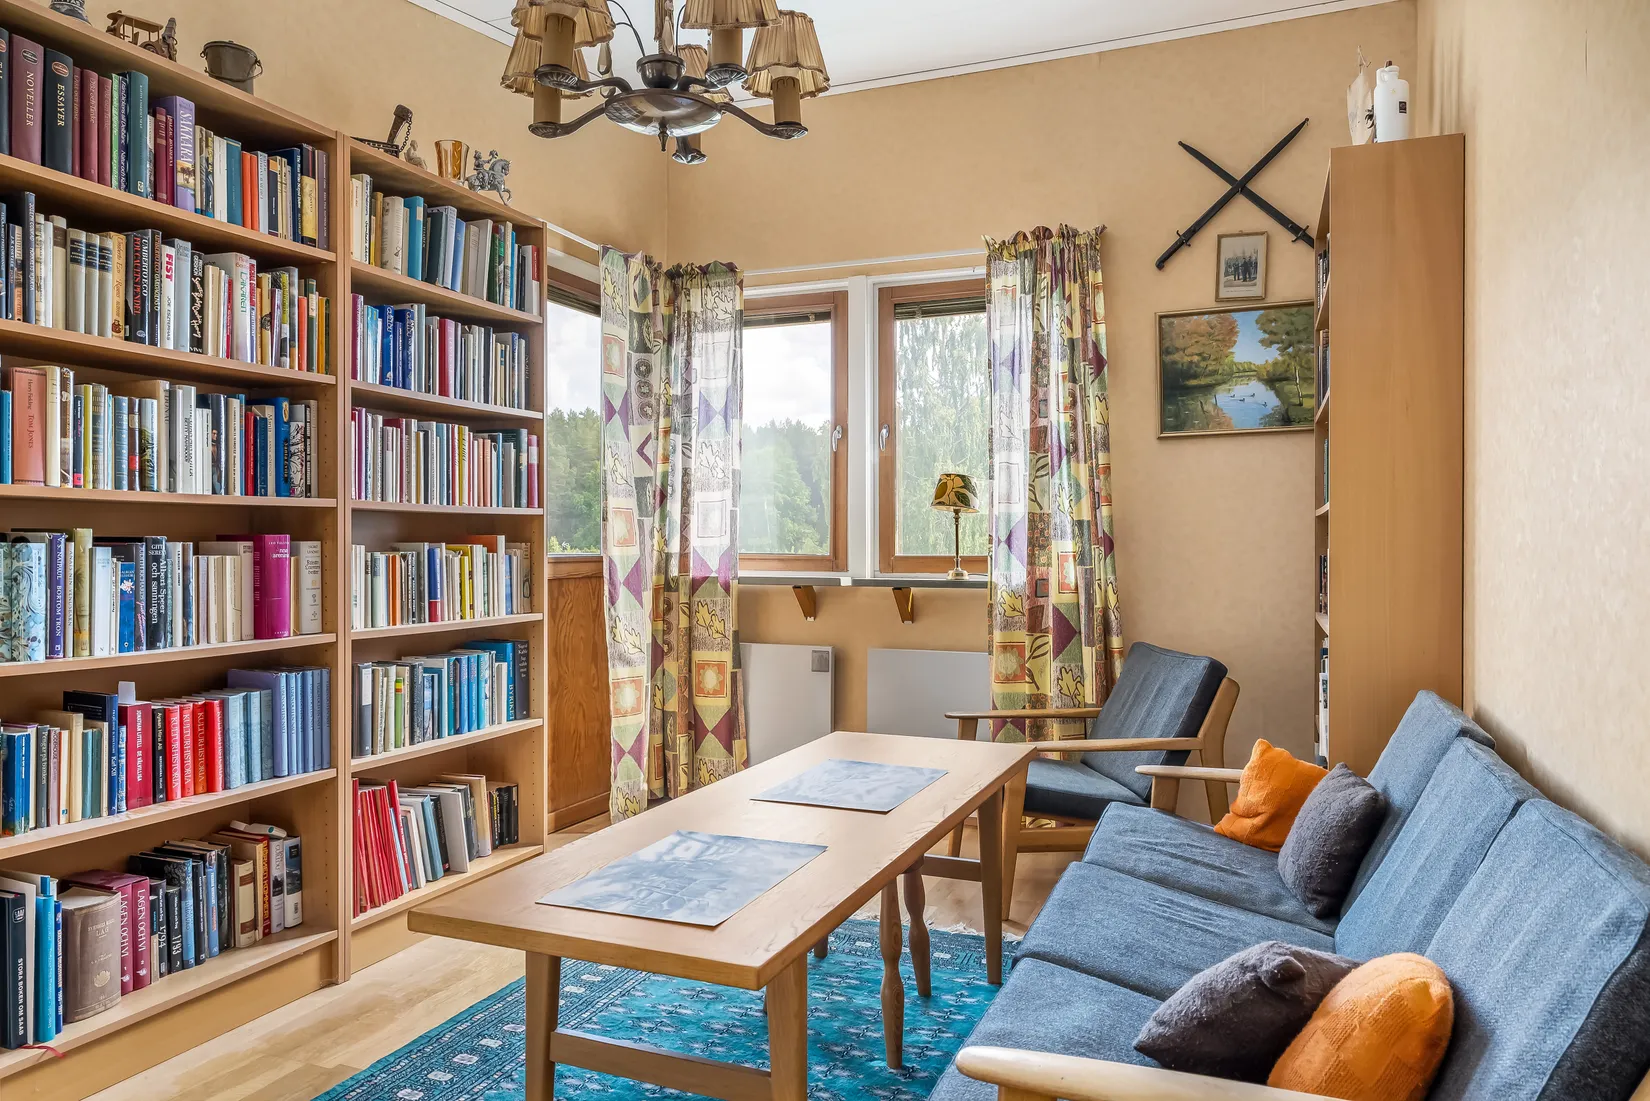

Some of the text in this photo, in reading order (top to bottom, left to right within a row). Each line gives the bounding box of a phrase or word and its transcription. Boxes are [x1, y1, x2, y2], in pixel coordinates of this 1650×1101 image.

[25, 71, 34, 127] NOVELLER
[57, 83, 65, 127] ESSAYER
[180, 110, 193, 162] SAKKARA
[133, 236, 141, 316] FOUCAULTS PENDEL
[150, 581, 158, 624] sanningen
[158, 591, 166, 614] Speer
[170, 716, 178, 789] KULTURHISTORIA
[183, 713, 191, 785] KULTURHISTORIA
[96, 927, 109, 936] LAG
[120, 892, 129, 958] LAGEN OCH VI
[137, 889, 146, 951] LAGEN OCH VI
[158, 925, 166, 948] 1794
[172, 934, 181, 955] 1793
[17, 1005, 24, 1015] OM
